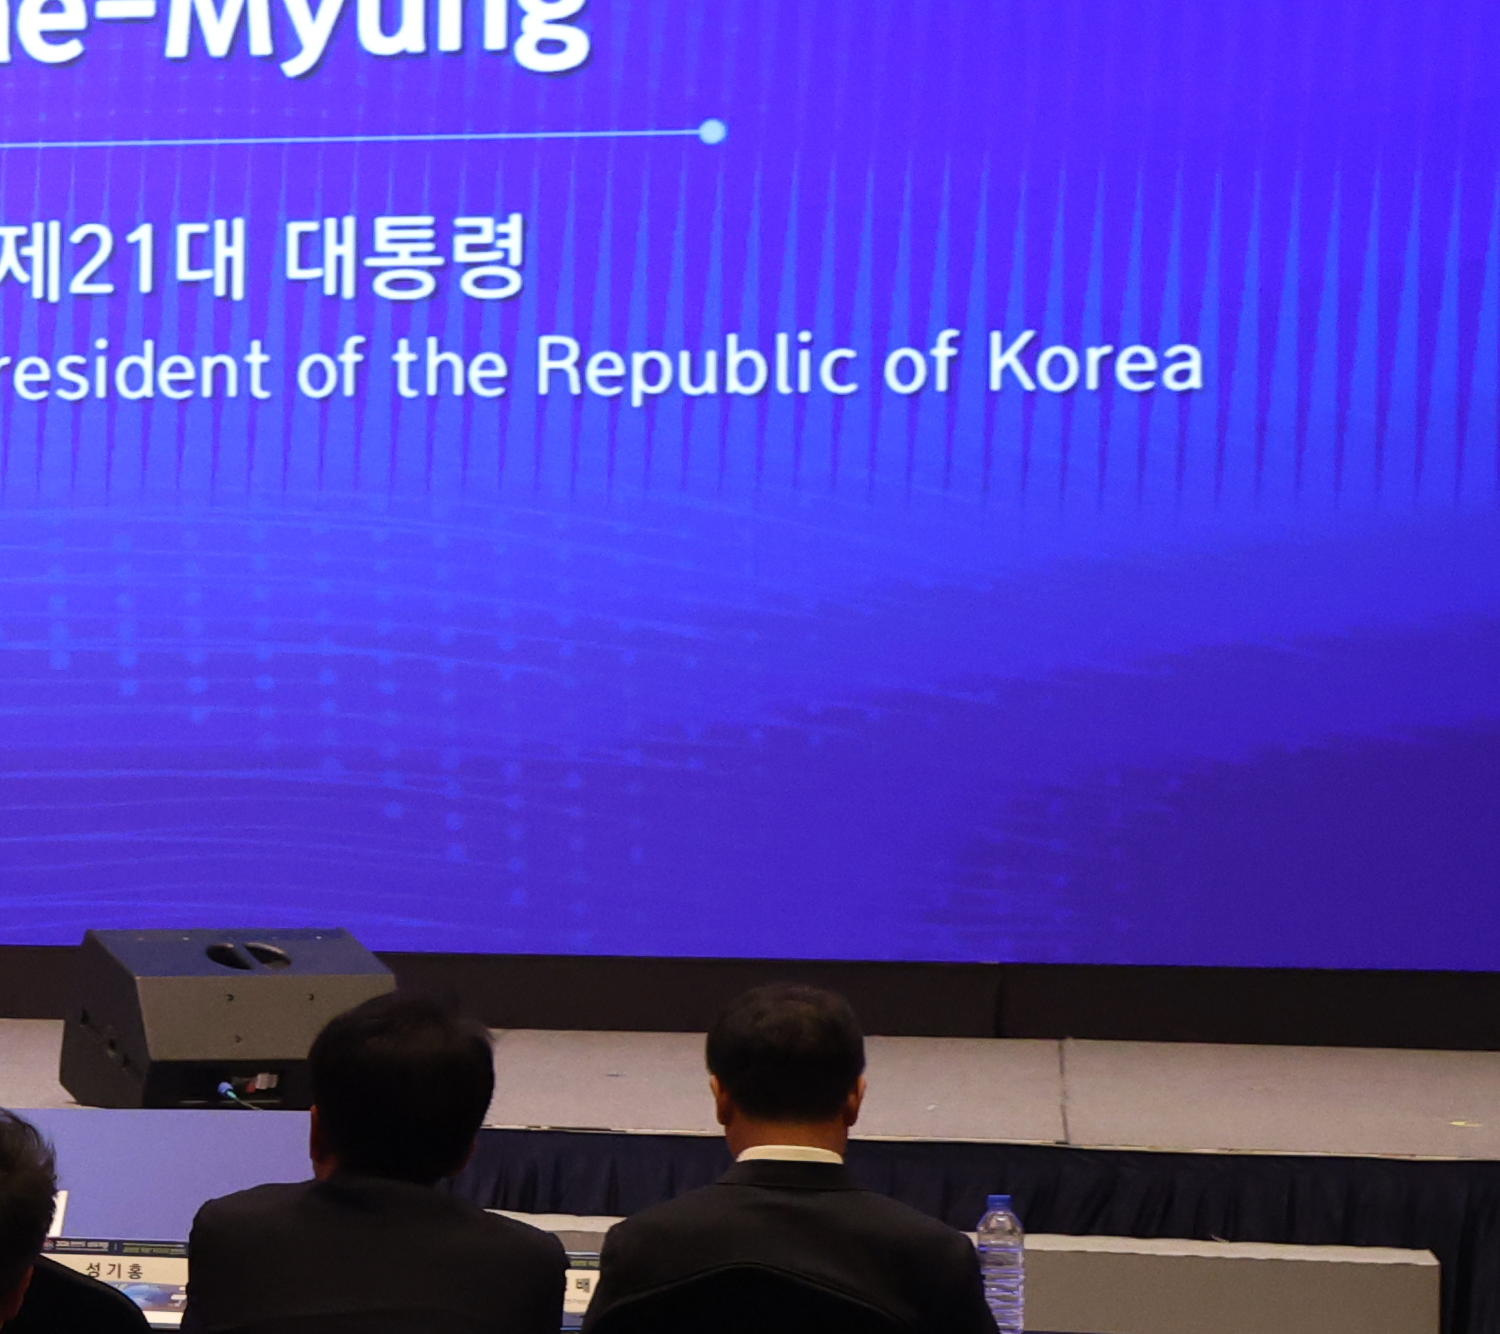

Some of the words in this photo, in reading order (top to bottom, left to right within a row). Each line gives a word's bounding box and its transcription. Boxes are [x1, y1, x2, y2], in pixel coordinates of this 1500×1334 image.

[286, 213, 522, 299] 대통령
[298, 336, 365, 398] of
[392, 337, 507, 398] the
[539, 331, 858, 407] Republic
[885, 329, 959, 393] of
[990, 330, 1202, 392] Korea
[86, 1262, 143, 1280] 성기홍
